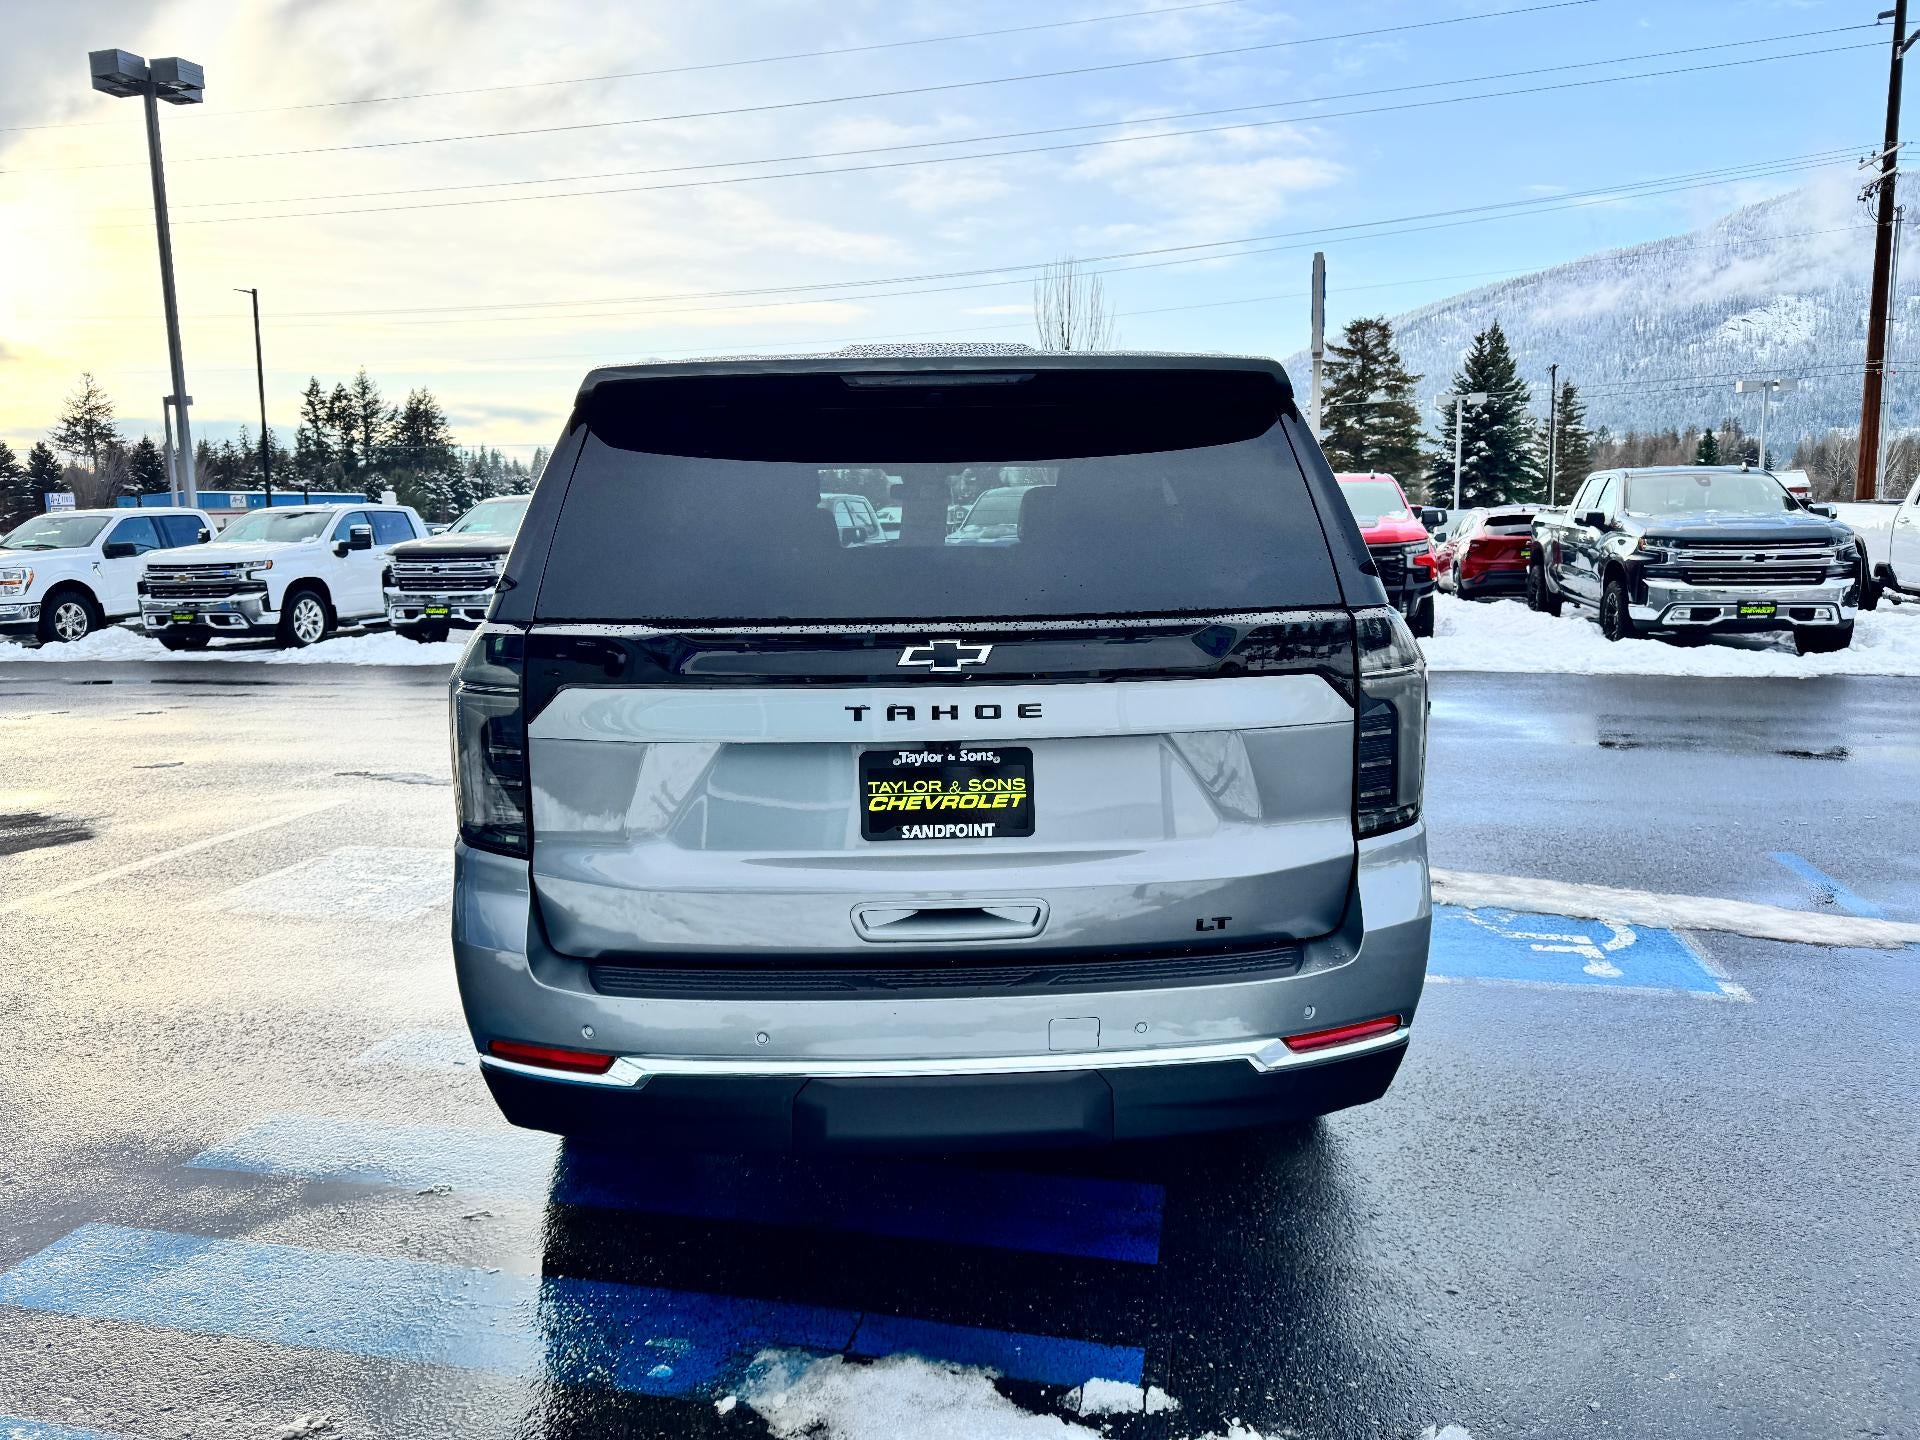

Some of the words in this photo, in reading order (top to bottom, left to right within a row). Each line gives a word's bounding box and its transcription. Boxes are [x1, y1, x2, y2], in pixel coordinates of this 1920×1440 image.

[844, 703, 1043, 721] TAHOE
[899, 751, 943, 766] Taylor
[947, 753, 956, 761] &
[959, 749, 994, 762] Sons
[868, 780, 942, 793] TAYLOR
[949, 780, 961, 795] &
[968, 777, 1026, 791] SONS
[868, 793, 1027, 812] CHEVROLET
[901, 822, 996, 839] SANDPOINT
[1196, 916, 1233, 931] LT
